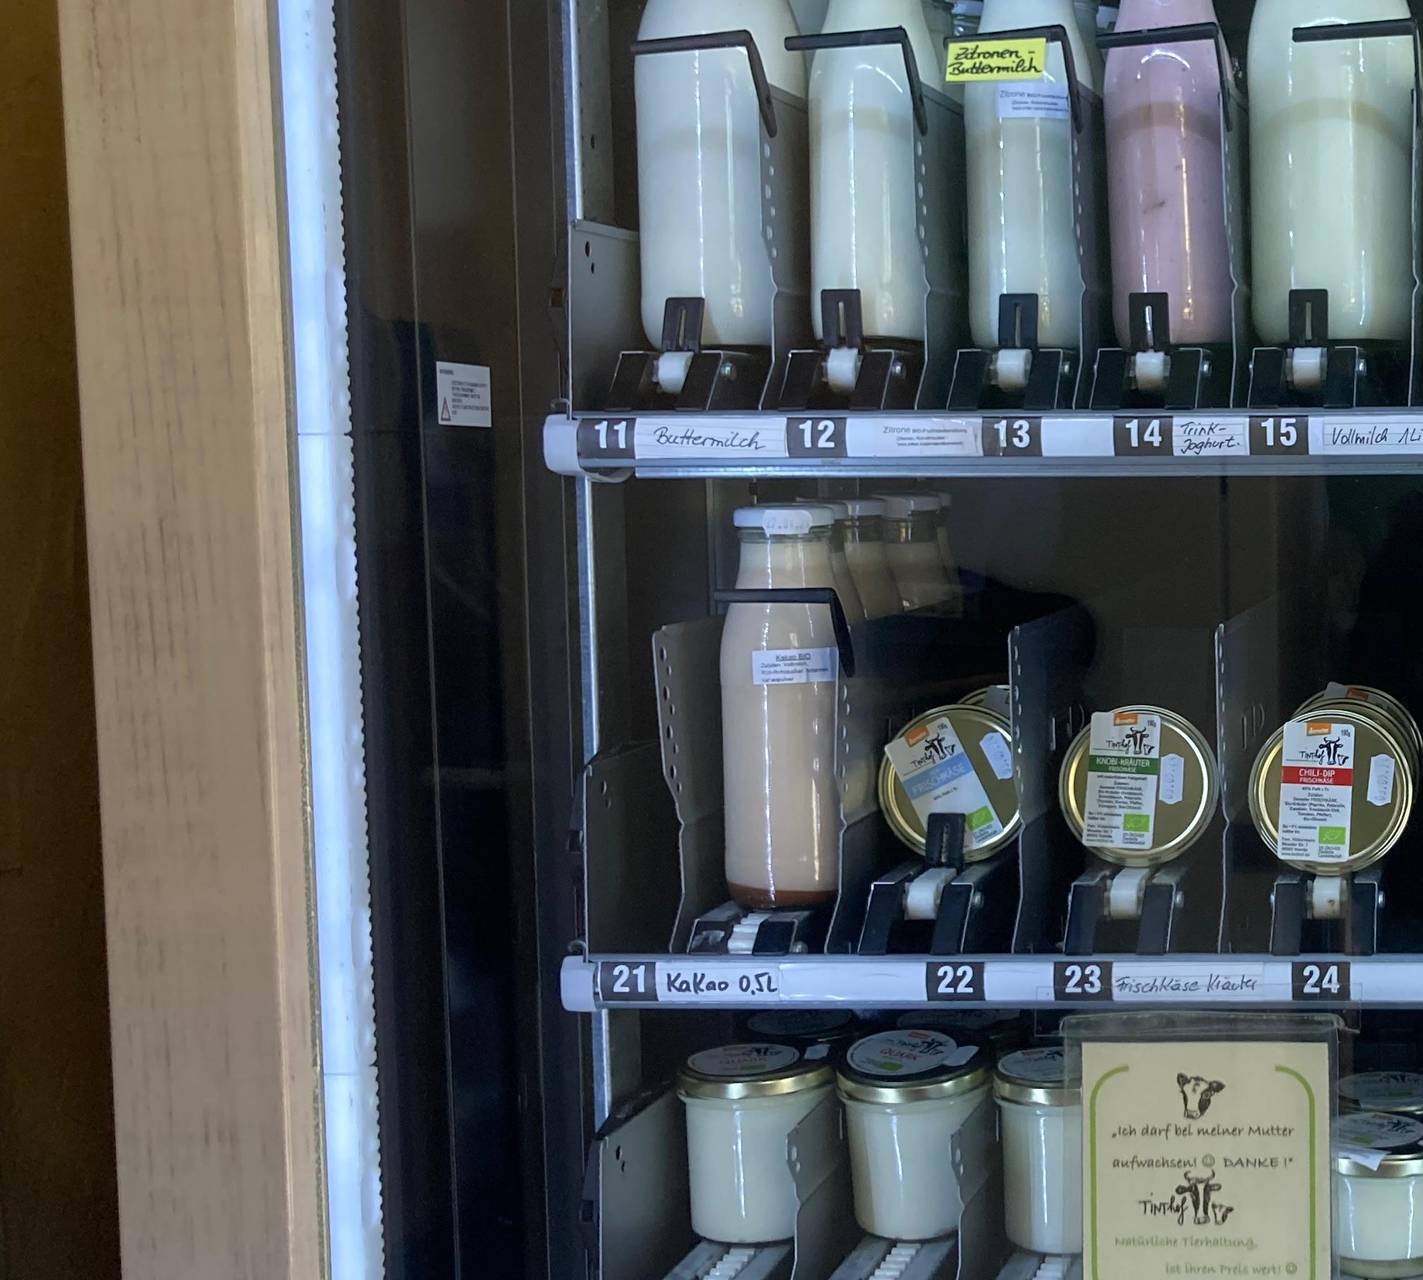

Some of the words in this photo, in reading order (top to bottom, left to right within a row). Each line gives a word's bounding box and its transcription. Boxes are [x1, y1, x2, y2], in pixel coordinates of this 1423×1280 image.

[947, 57, 1042, 76] Buttermilch
[594, 420, 627, 449] 11
[653, 426, 766, 450] Buttermilch
[799, 420, 835, 449] 12
[994, 419, 1030, 448] 13
[1125, 419, 1162, 447] 14
[1261, 418, 1297, 446] 15
[1332, 425, 1388, 445] Vollmilch
[1299, 768, 1336, 778] CHILI-DIP
[612, 965, 646, 993] 21
[936, 965, 973, 993] 22
[1064, 965, 1101, 993] 23
[1302, 965, 1340, 993] 24
[1141, 1123, 1171, 1140] darf
[1174, 1124, 1193, 1137] bei
[1197, 1125, 1244, 1137] meiner
[1248, 1125, 1295, 1138] Mutter
[1112, 1153, 1197, 1171] aufwachsen!
[1223, 1156, 1279, 1169] DANKE
[1114, 1235, 1178, 1248] Natürliche
[1165, 1263, 1181, 1275] ist
[1184, 1263, 1215, 1275] ihren
[1219, 1264, 1249, 1275] Preis
[1252, 1264, 1281, 1276] wert!
